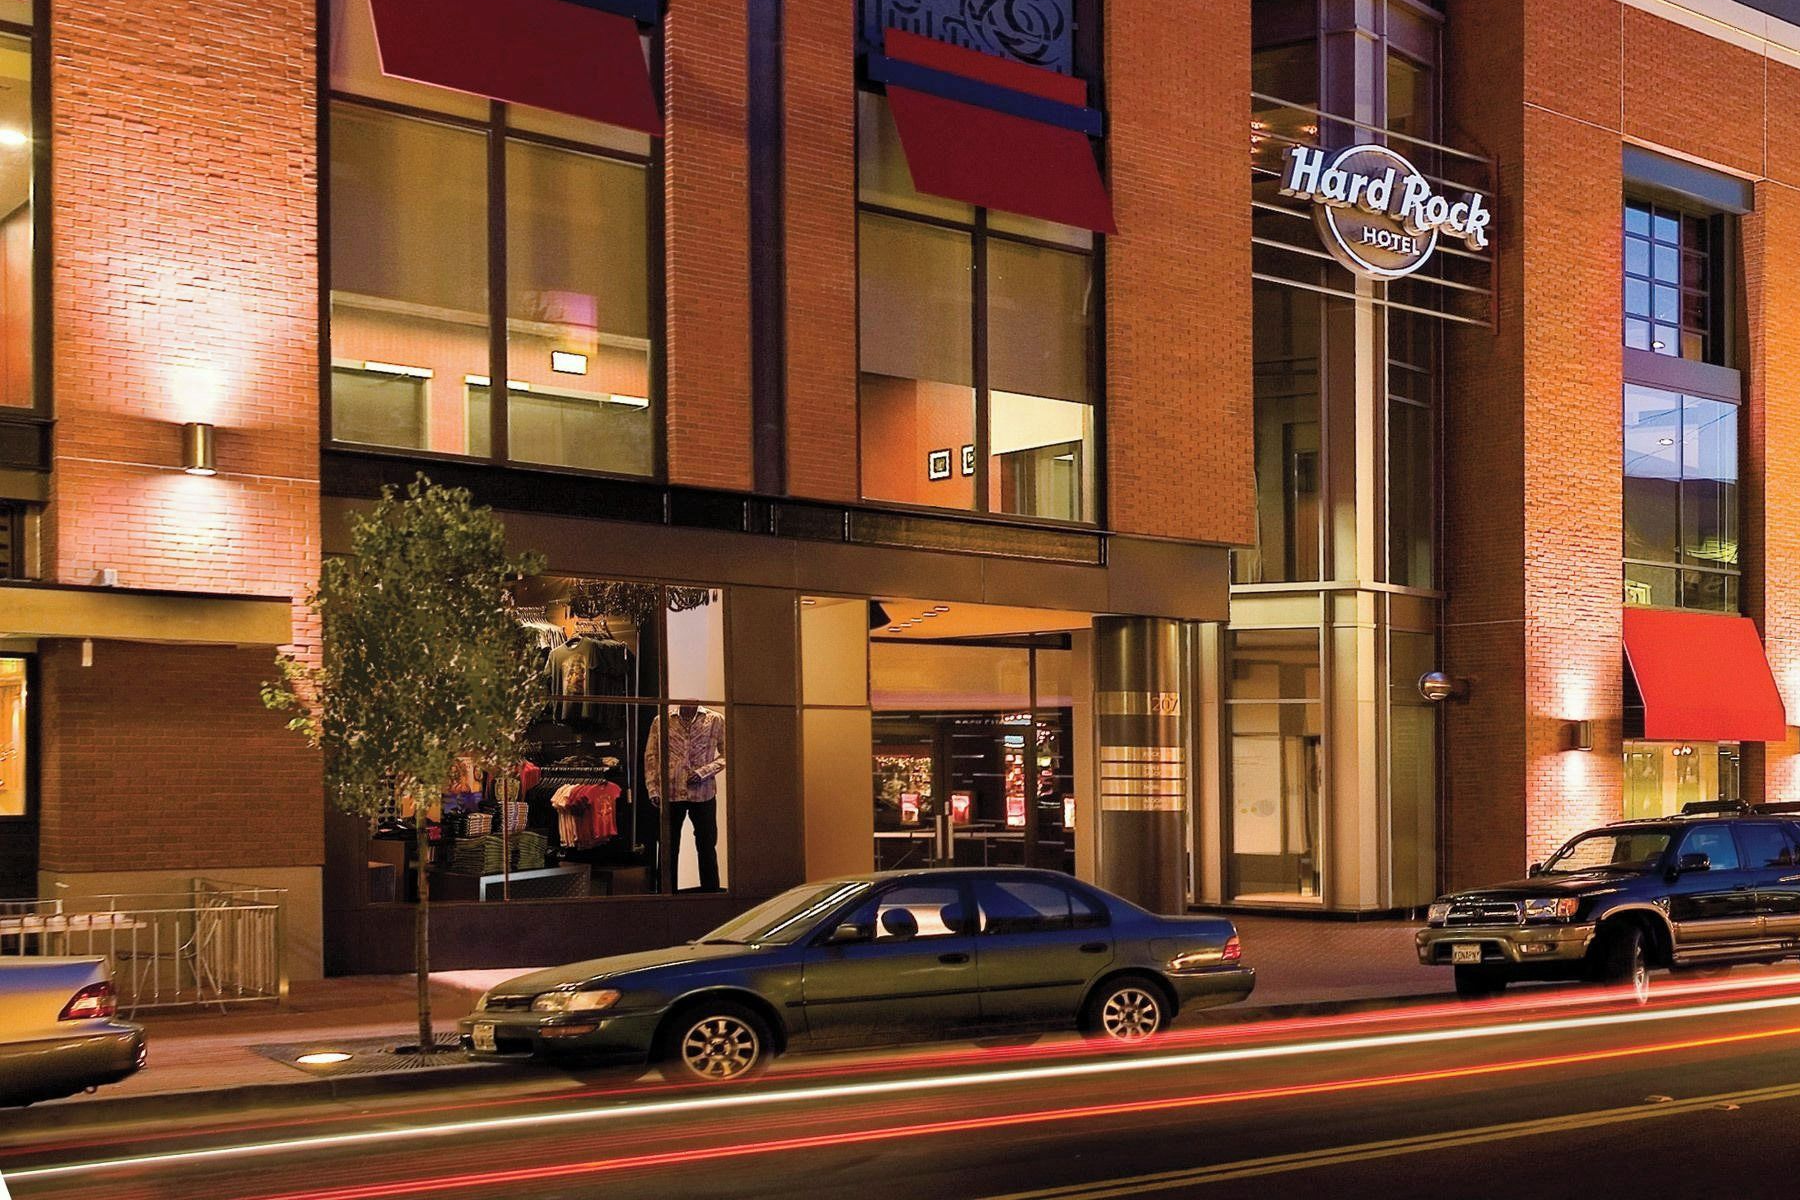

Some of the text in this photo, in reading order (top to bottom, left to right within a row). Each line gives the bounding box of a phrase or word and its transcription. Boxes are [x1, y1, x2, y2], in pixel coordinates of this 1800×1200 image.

[1290, 145, 1491, 247] Hard Rock
[1362, 226, 1421, 256] HOTEL
[1151, 696, 1179, 713] 207
